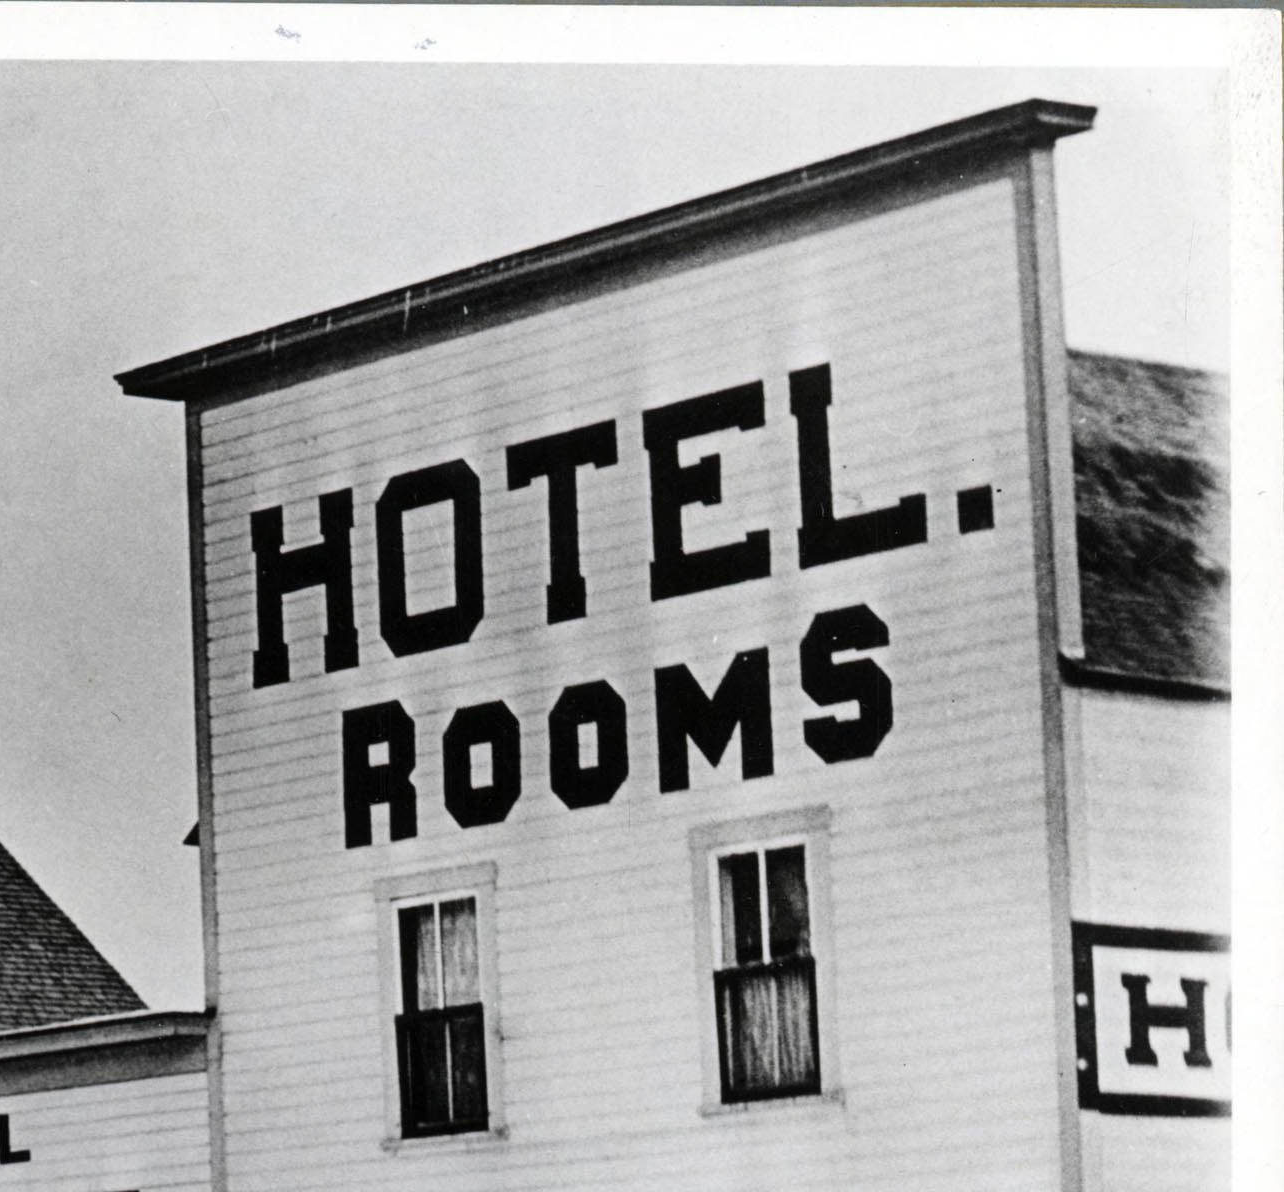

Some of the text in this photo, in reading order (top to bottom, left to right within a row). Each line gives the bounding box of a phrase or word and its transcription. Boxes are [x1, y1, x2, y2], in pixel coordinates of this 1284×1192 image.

[250, 362, 996, 690] HOTEL.
[342, 602, 895, 849] ROOMS
[1120, 971, 1232, 1068] H
